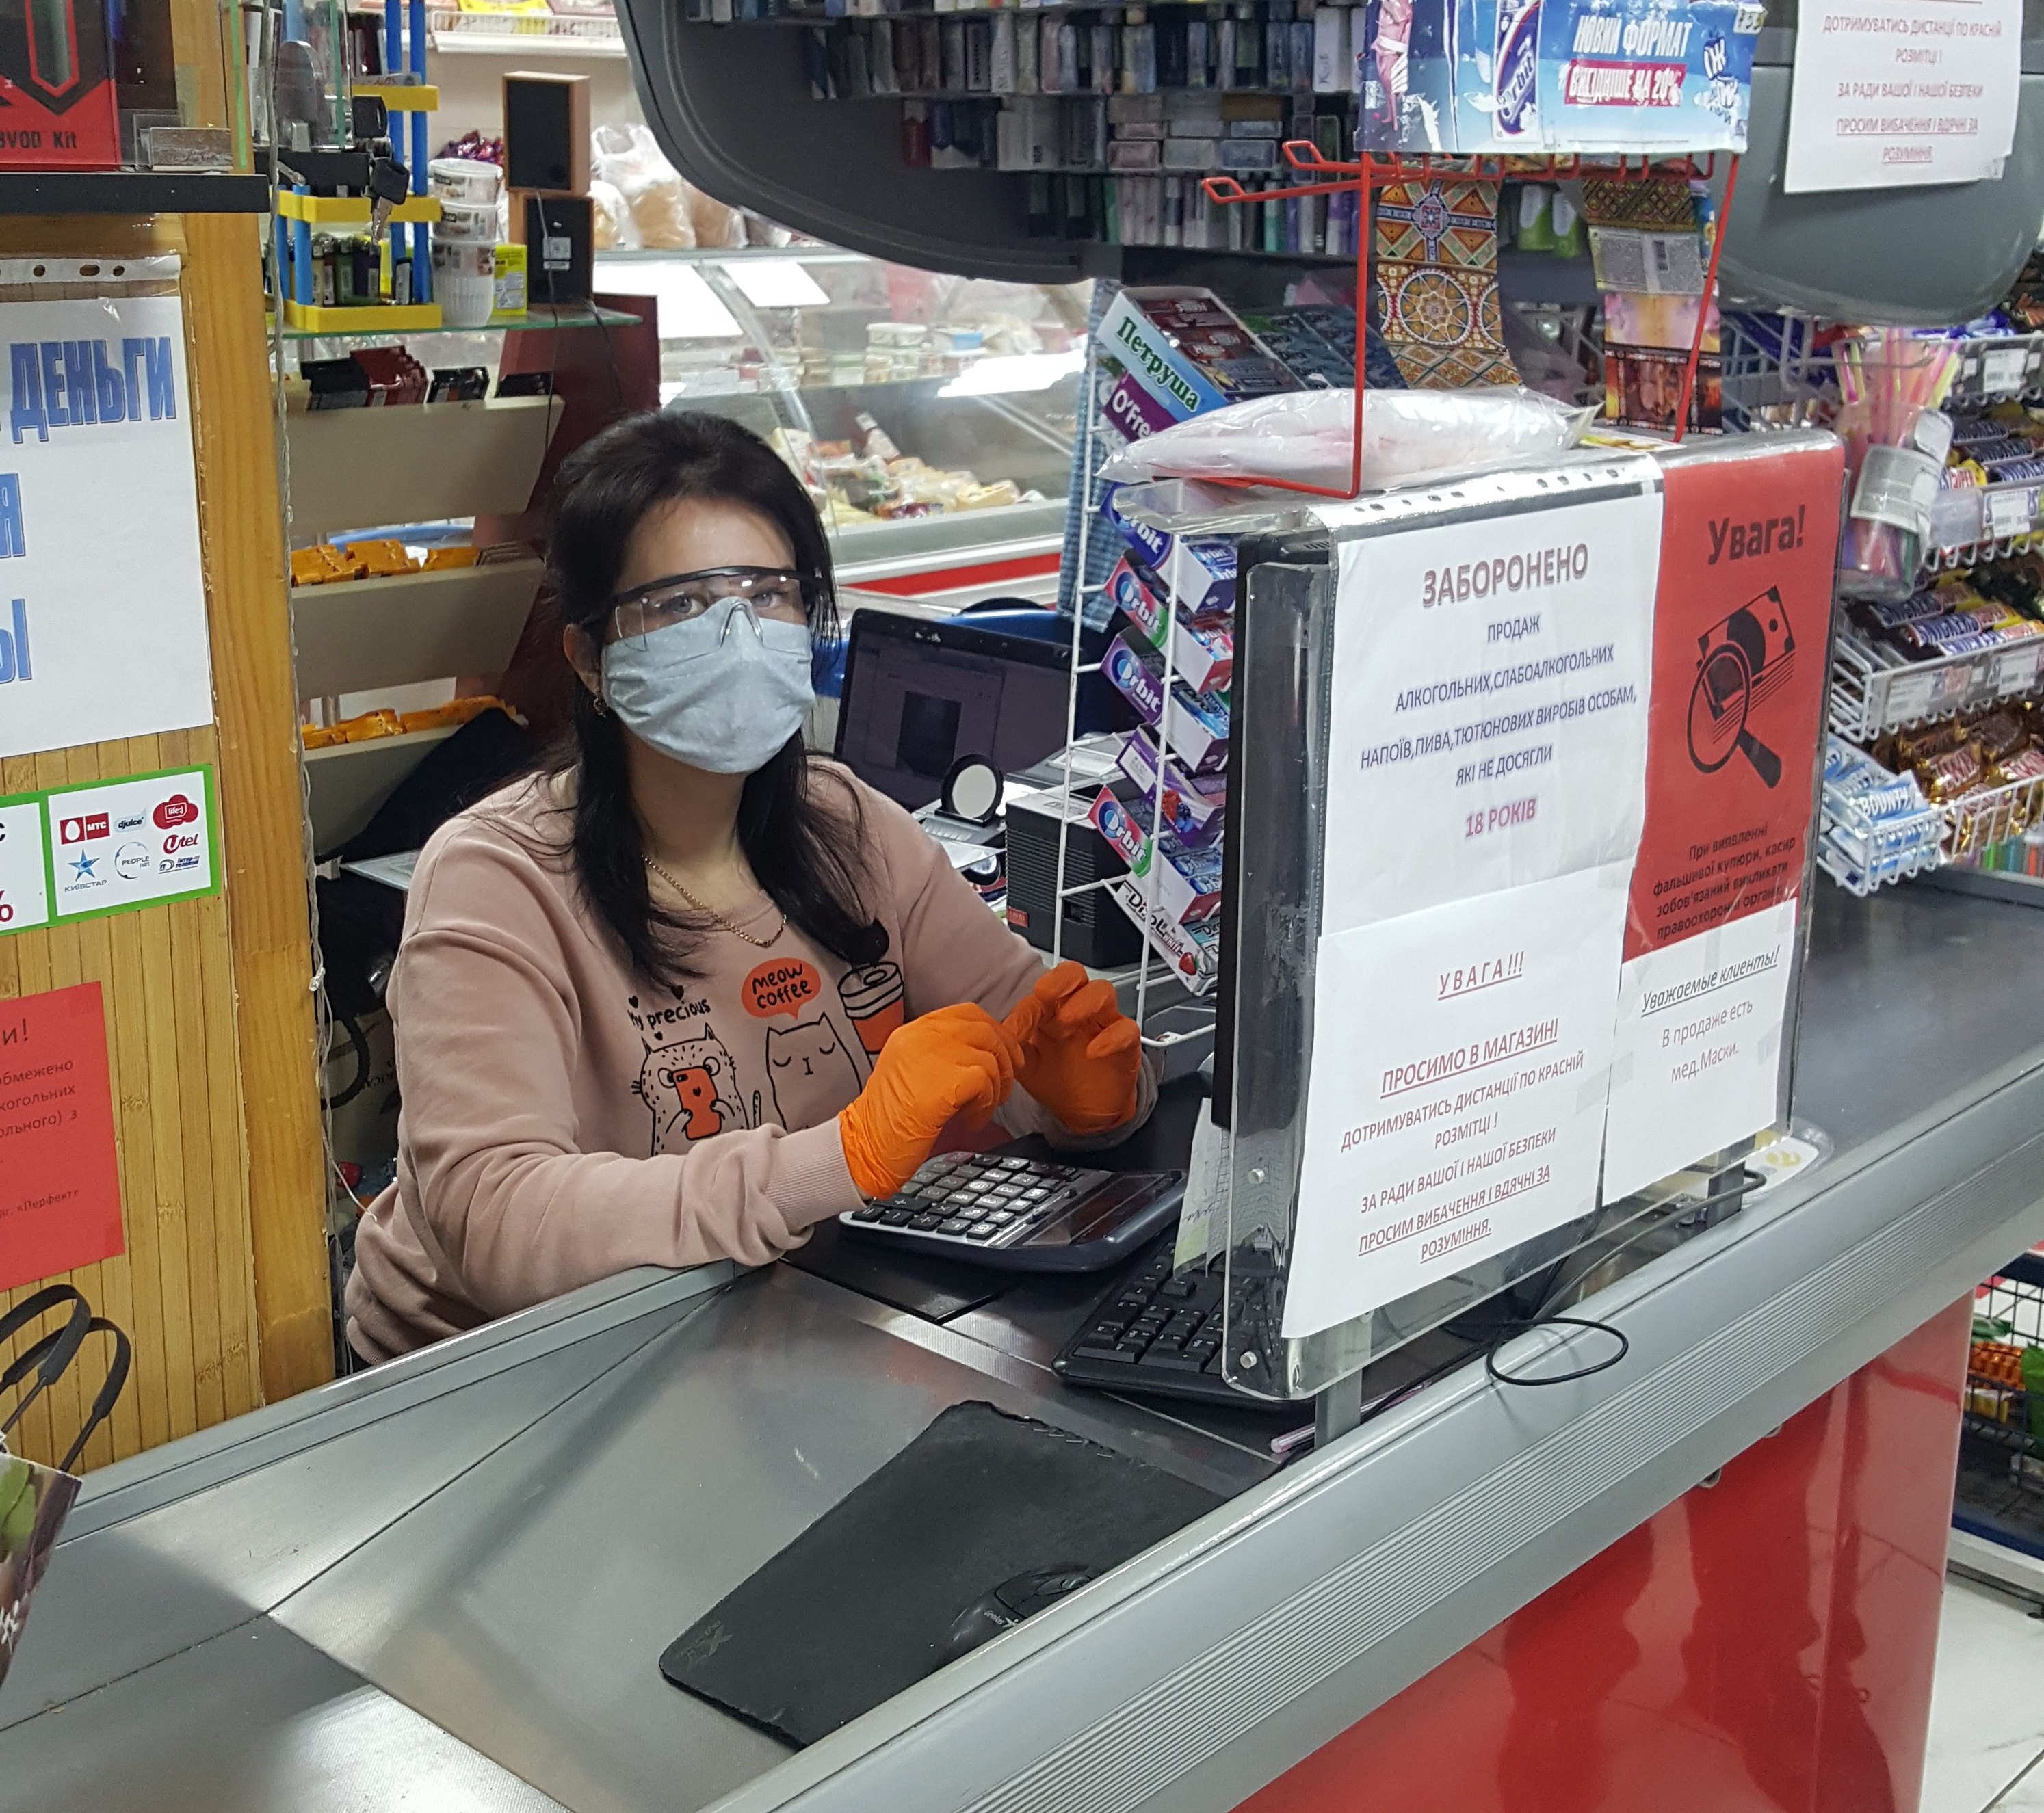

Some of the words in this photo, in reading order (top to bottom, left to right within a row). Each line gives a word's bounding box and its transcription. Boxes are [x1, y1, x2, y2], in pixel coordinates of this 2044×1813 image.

[1623, 19, 1693, 57] ФОРМАТ
[1116, 315, 1201, 413] Петруша
[10, 336, 177, 444] ДЕНЬГИ
[1708, 504, 1806, 565] Увага!
[1422, 543, 1588, 609] ЗАБОРОНЕНО
[1119, 580, 1162, 633] Orbit
[1487, 615, 1541, 642] ПРОДАЖ
[1117, 658, 1162, 713] Orbit
[1536, 697, 1585, 726] ВИРОБІВ
[1588, 685, 1637, 713] ОСОБАМ,
[1456, 765, 1475, 786] ЯКІ
[1478, 759, 1493, 778] НЕ
[1496, 745, 1553, 778] ДОСЯГЛИ
[1465, 814, 1484, 838] 18
[1489, 798, 1536, 832] РОКІВ
[1859, 786, 1909, 817] BOUNTY
[163, 834, 199, 854] Utel
[1104, 809, 1148, 864] Orbit
[1690, 844, 1709, 862] При
[1713, 822, 1767, 853] виявленні
[122, 856, 150, 866] PEOPLE
[1653, 860, 1714, 898] фальшивої
[1765, 837, 1795, 857] касир
[757, 979, 813, 1009] coffee
[1641, 970, 1716, 1015] Уважаемые
[1719, 944, 1780, 986] клиенты!
[646, 998, 711, 1030] precious
[1662, 1029, 1670, 1048] В
[1673, 1008, 1727, 1046] продаже
[1729, 1000, 1753, 1022] есть
[0, 1060, 74, 1087] бмежено
[1381, 1047, 1465, 1096] ПРОСИМО
[1470, 1043, 1479, 1066] В
[1483, 1018, 1559, 1063] МАГАЗИНІ
[1341, 1098, 1452, 1153] ДОТРИМУВАТИСЬ
[1454, 1072, 1518, 1115] ДИСТАНЦІЇ
[1519, 1069, 1535, 1088] ПО
[1538, 1050, 1584, 1083] КРАСНІЙ
[1435, 1115, 1491, 1150] РОЗМІТЦІ
[1361, 1195, 1377, 1214] ЗА
[1380, 1181, 1415, 1207] РАДИ
[1417, 1160, 1460, 1192] ВАШОЇ
[1467, 1145, 1508, 1176] НАШОЇ
[1508, 1127, 1556, 1159] БЕЗПЕКИ
[1359, 1218, 1414, 1254] ПРОСИМ
[1417, 1192, 1486, 1234] ВИБАЧЕННЯ
[1494, 1174, 1537, 1201] ВДЯЧНІ
[1536, 1164, 1551, 1182] ЗА
